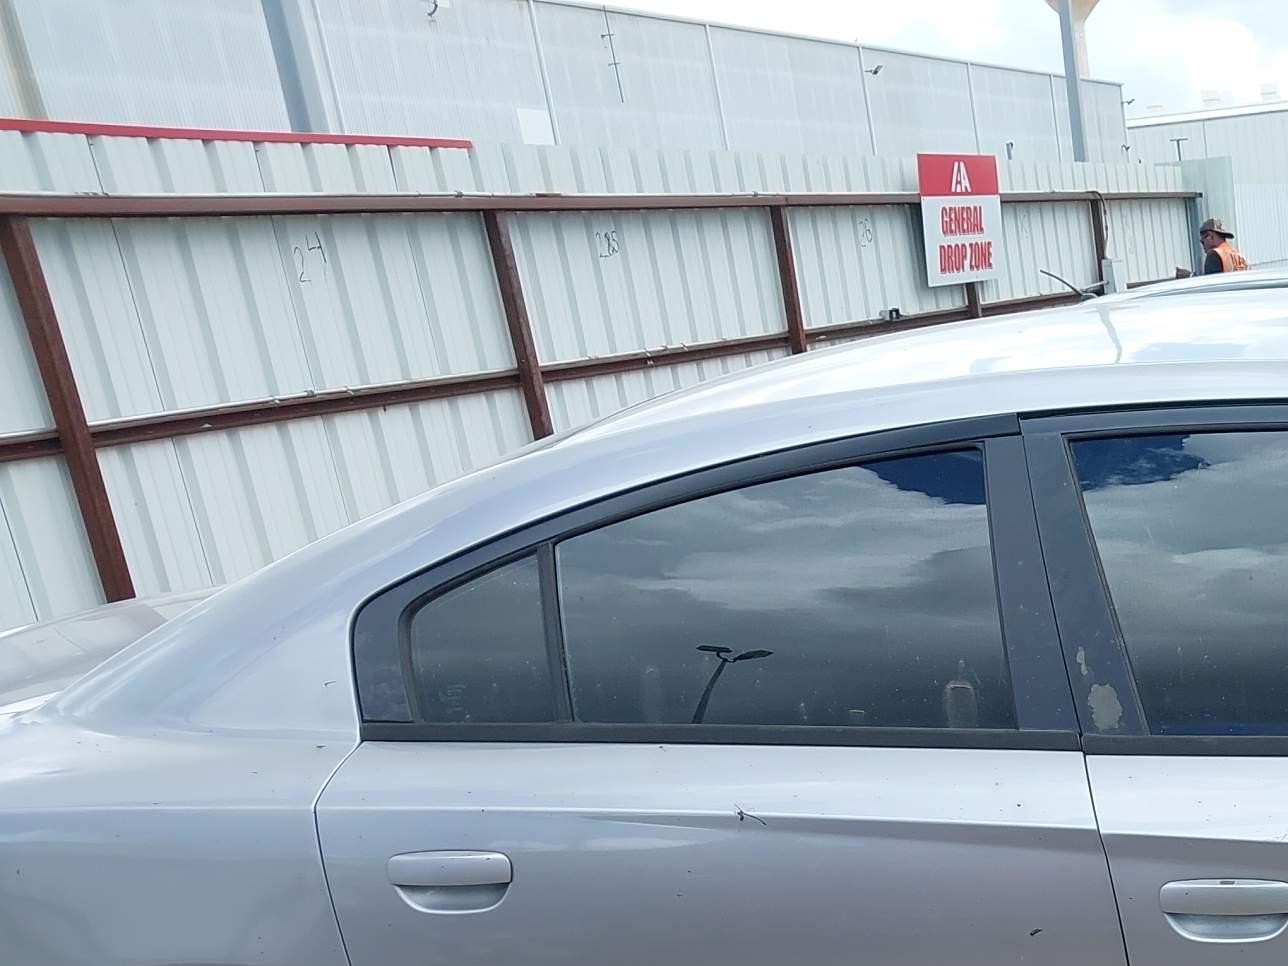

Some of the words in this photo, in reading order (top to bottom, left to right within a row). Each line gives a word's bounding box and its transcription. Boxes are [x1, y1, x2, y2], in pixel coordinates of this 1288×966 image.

[941, 205, 984, 235] GENERAL
[939, 243, 967, 273] DROP
[969, 241, 992, 271] ZONE
